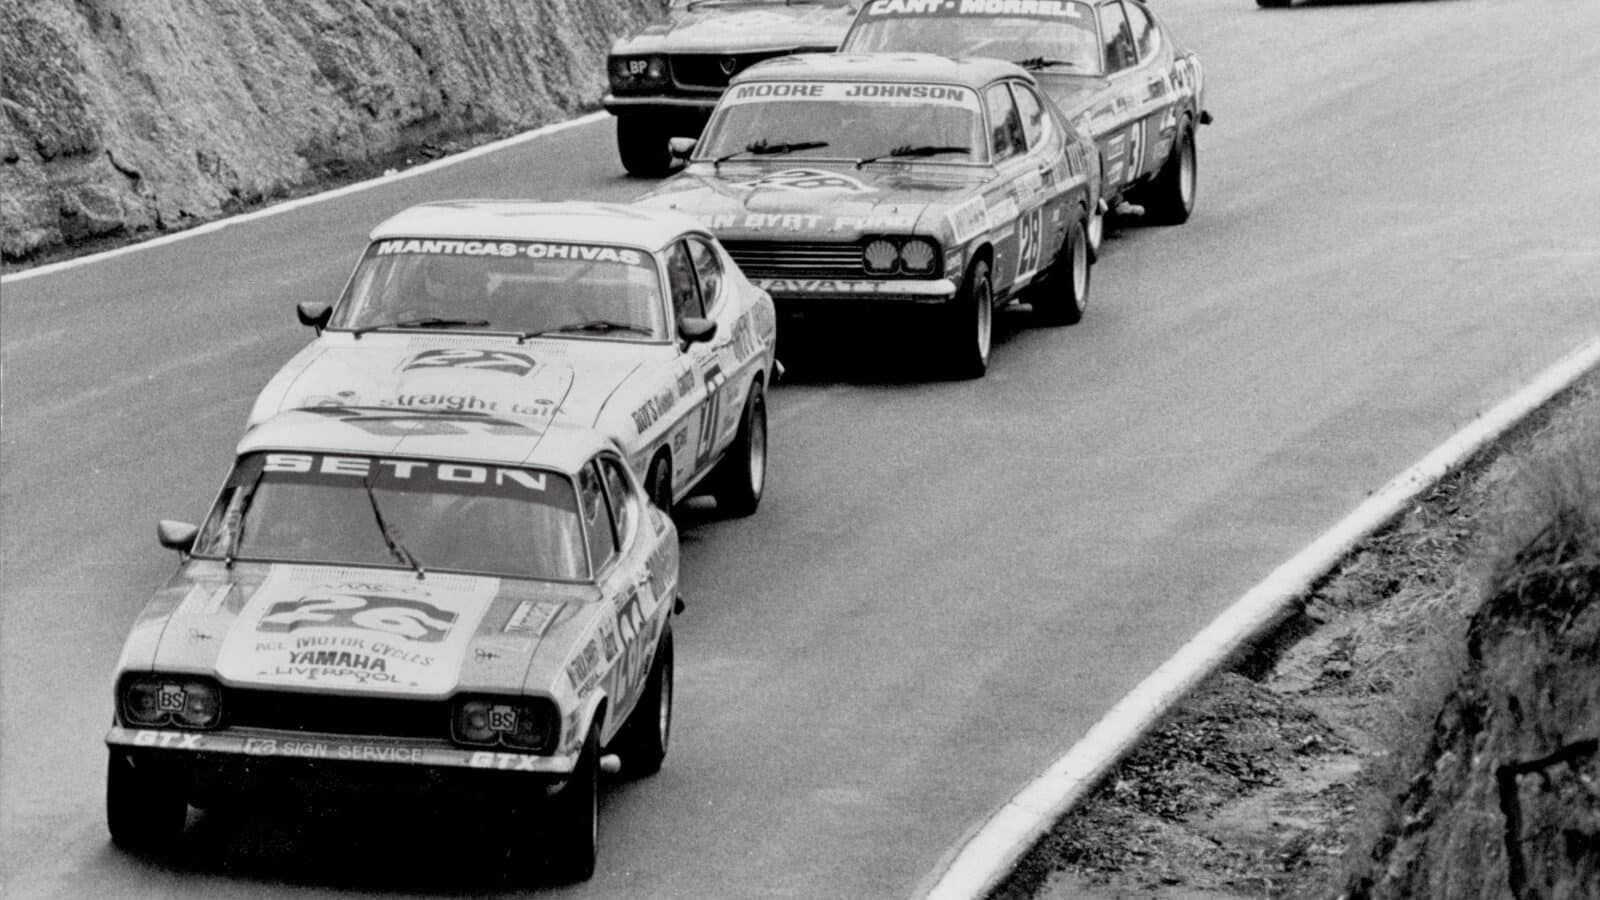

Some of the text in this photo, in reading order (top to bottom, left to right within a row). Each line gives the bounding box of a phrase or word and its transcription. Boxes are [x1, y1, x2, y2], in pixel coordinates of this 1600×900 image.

[629, 60, 649, 75] BP
[736, 84, 964, 102] MOORE JOHNSON
[744, 213, 823, 231] BYRT
[1018, 210, 1042, 276] 28
[263, 454, 547, 491] SETON
[296, 635, 364, 650] MOTOR
[289, 650, 386, 672] YAMAHA
[274, 665, 401, 684] LIVERPOOL
[161, 693, 182, 709] BS
[491, 713, 514, 729] BS
[133, 730, 204, 749] GTX
[283, 742, 328, 757] SIGN
[338, 746, 424, 763] SERVICE
[470, 752, 540, 770] GTX
